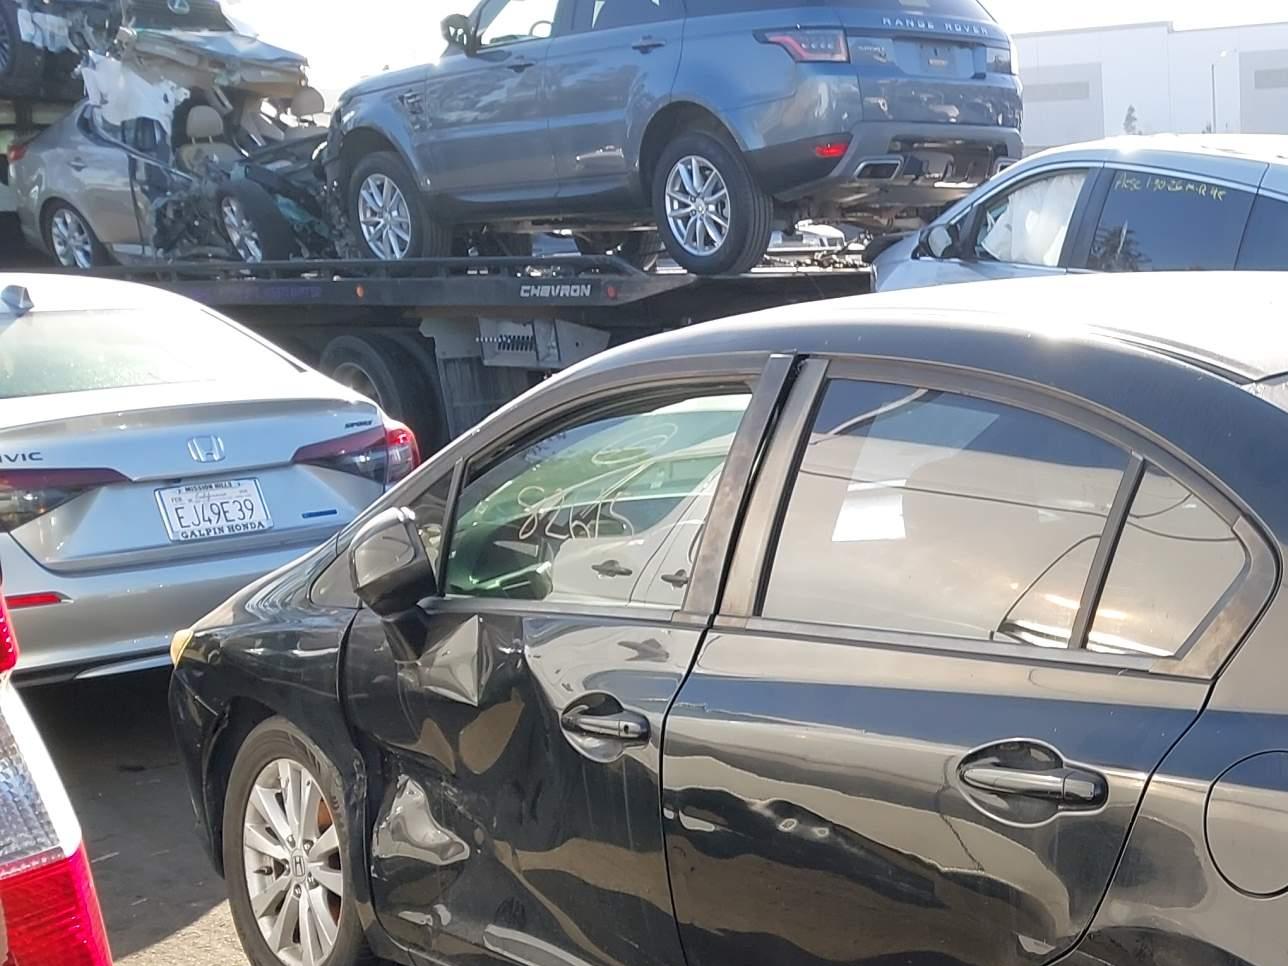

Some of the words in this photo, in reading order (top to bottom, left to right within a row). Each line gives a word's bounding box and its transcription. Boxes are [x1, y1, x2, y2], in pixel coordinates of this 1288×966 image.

[882, 17, 934, 29] RANGE
[944, 23, 988, 34] ROVER
[520, 284, 591, 297] CHEVRON
[175, 499, 254, 528] EJ49E39
[181, 527, 225, 539] GALPIN
[227, 521, 265, 533] HONDA
